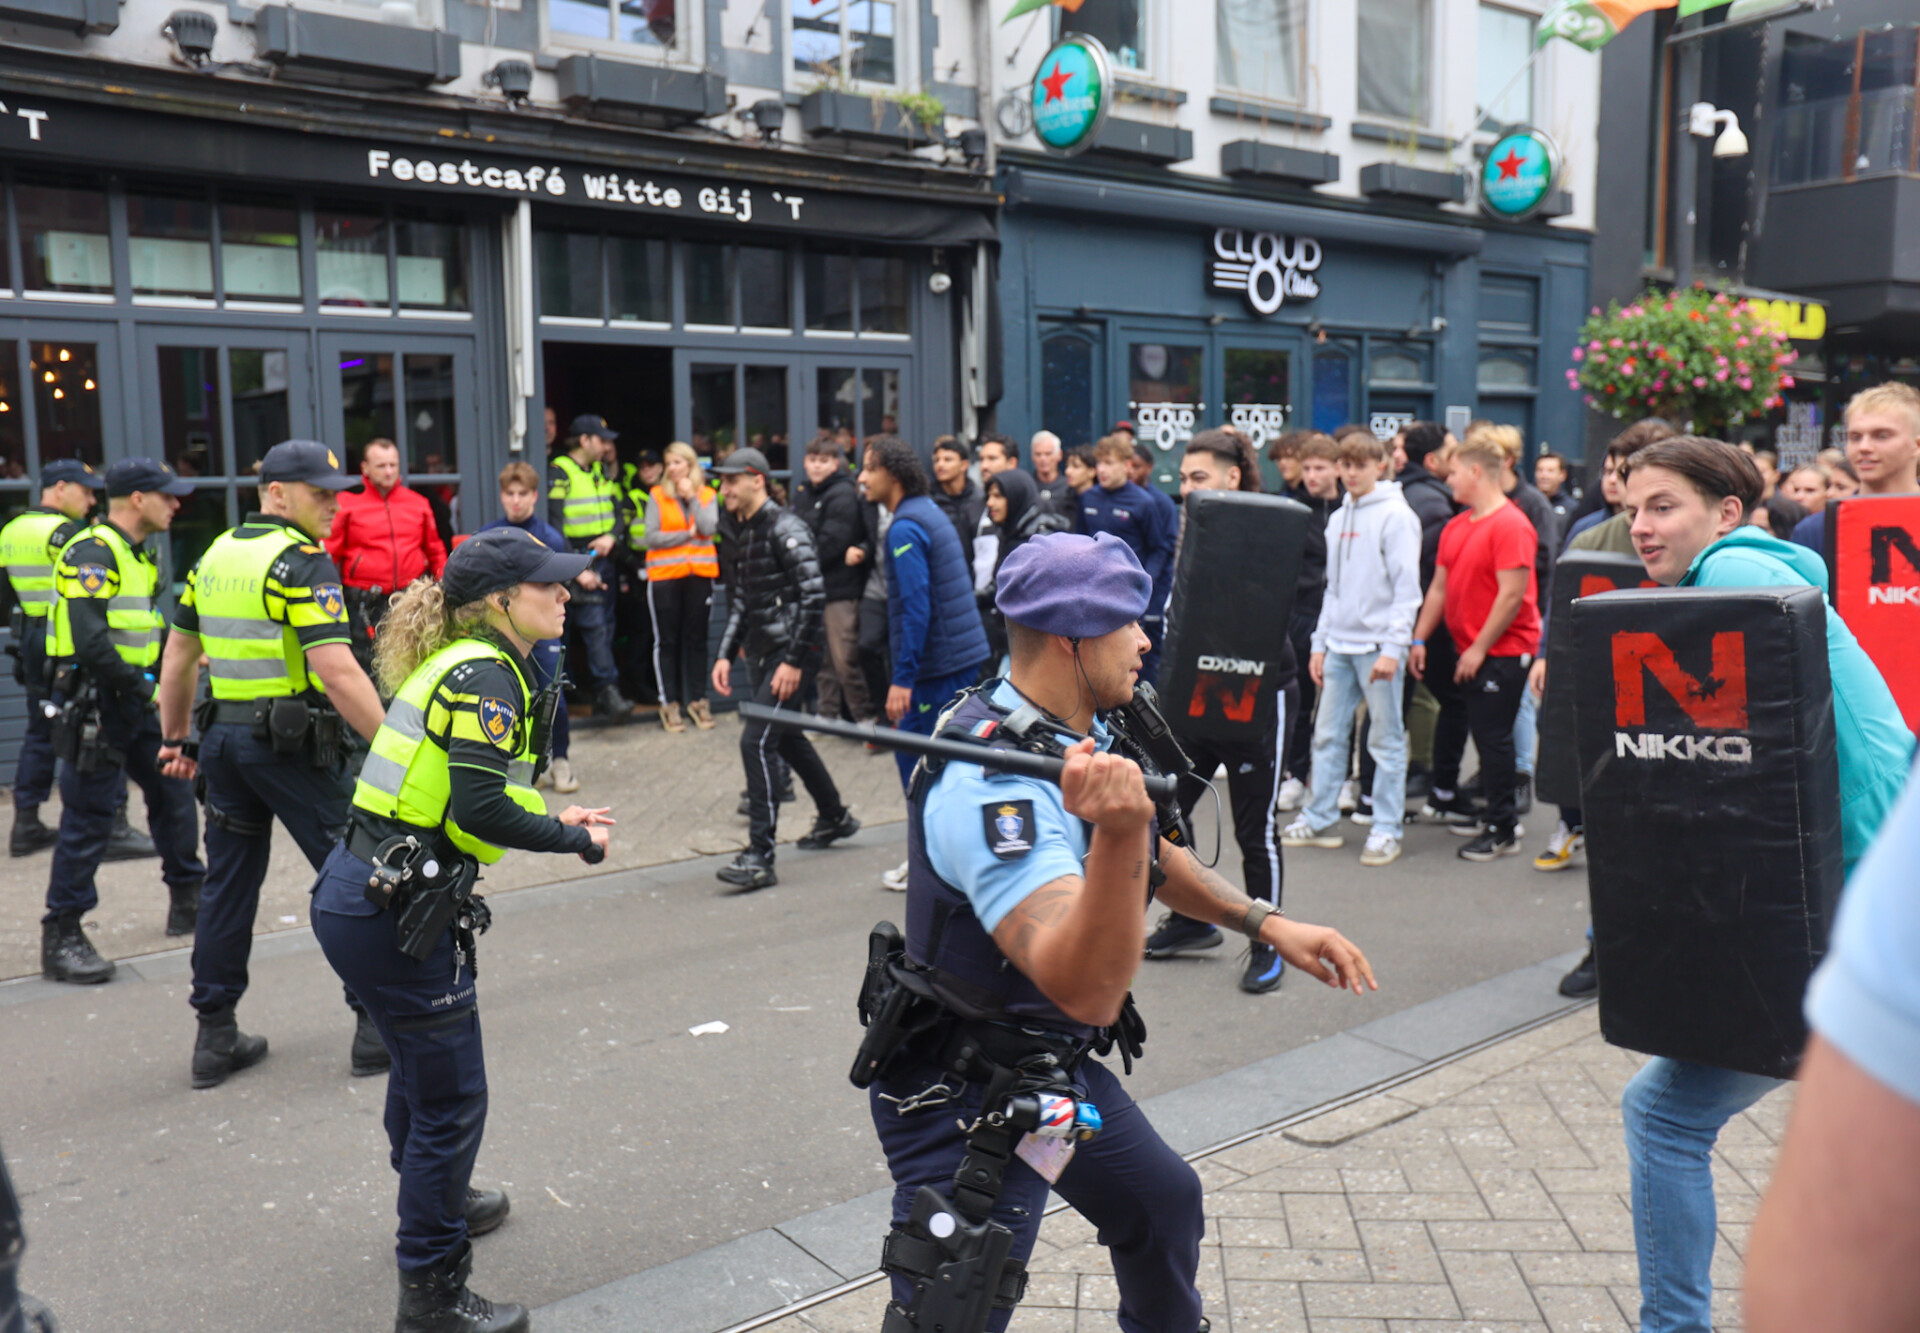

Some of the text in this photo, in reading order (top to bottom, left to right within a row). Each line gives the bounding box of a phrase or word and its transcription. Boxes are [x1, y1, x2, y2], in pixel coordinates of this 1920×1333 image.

[368, 149, 567, 196] Feestcafé
[583, 173, 683, 209] Witte
[698, 187, 753, 222] Gij
[1198, 655, 1265, 676] NIKKO
[1615, 731, 1752, 764] NIKKO
